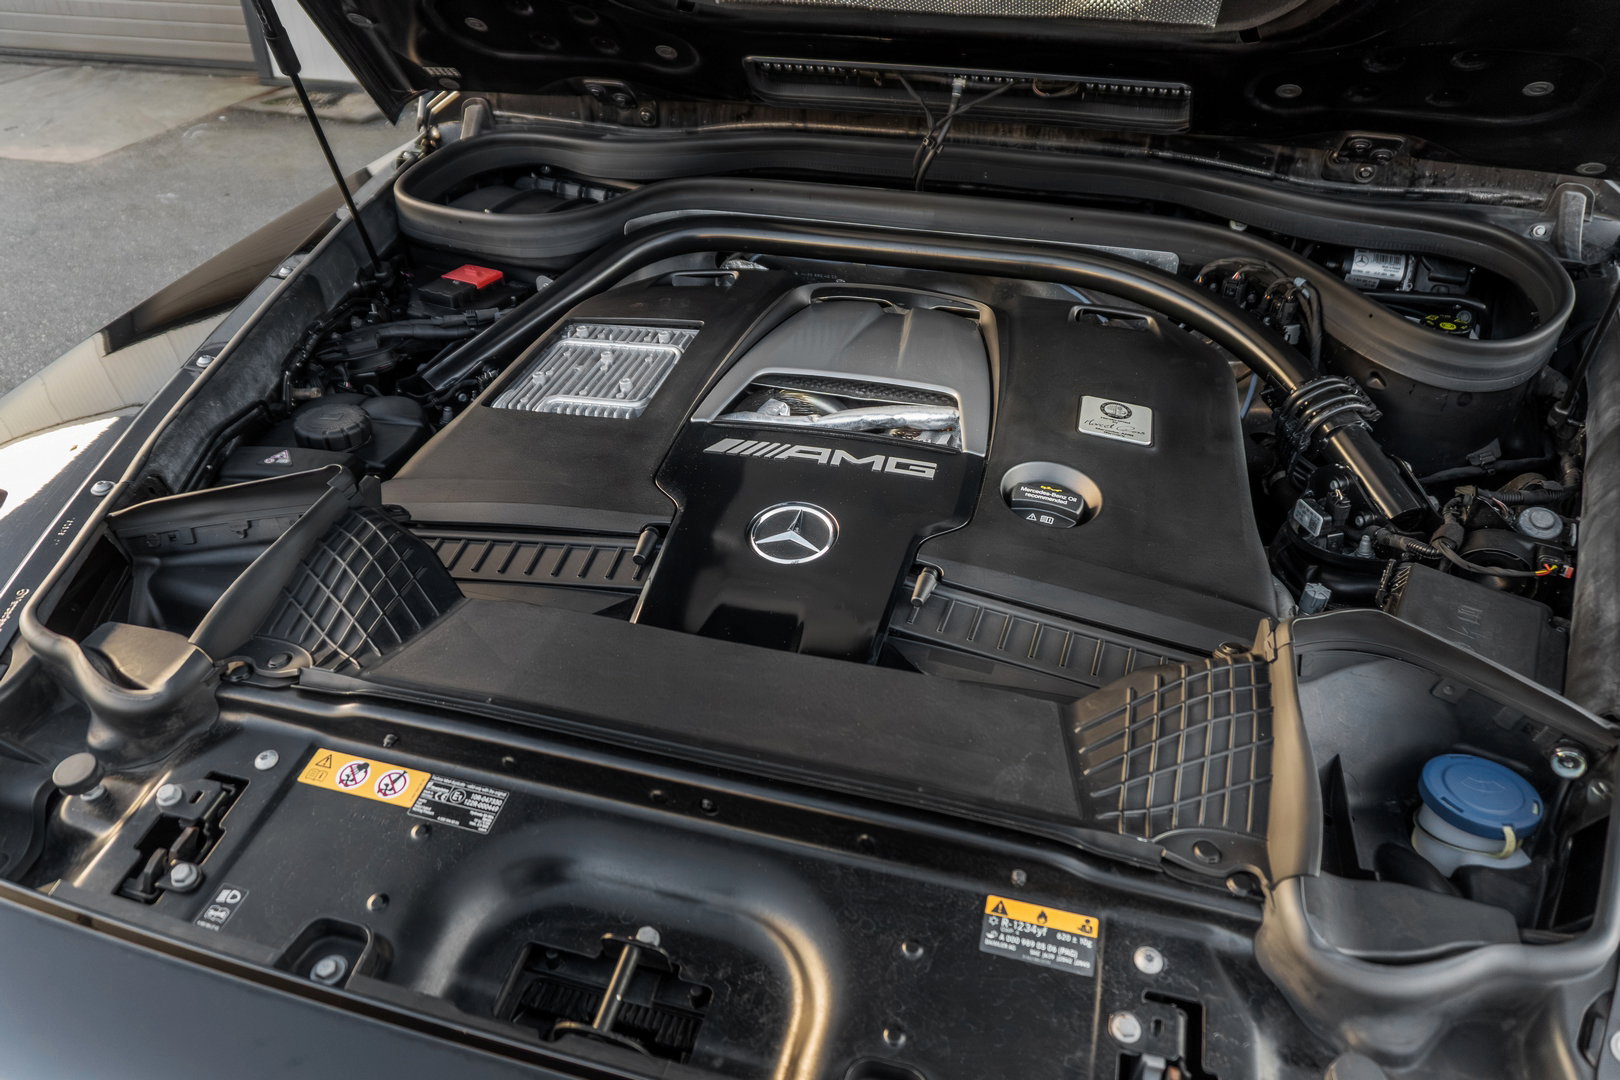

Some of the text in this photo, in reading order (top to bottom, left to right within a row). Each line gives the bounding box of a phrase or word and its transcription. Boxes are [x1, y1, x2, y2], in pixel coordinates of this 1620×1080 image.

[774, 444, 938, 480] AMG
[1020, 486, 1067, 500] Mercedes-Benz
[1024, 492, 1068, 505] recommended
[1000, 917, 1048, 938] R-1234yf
